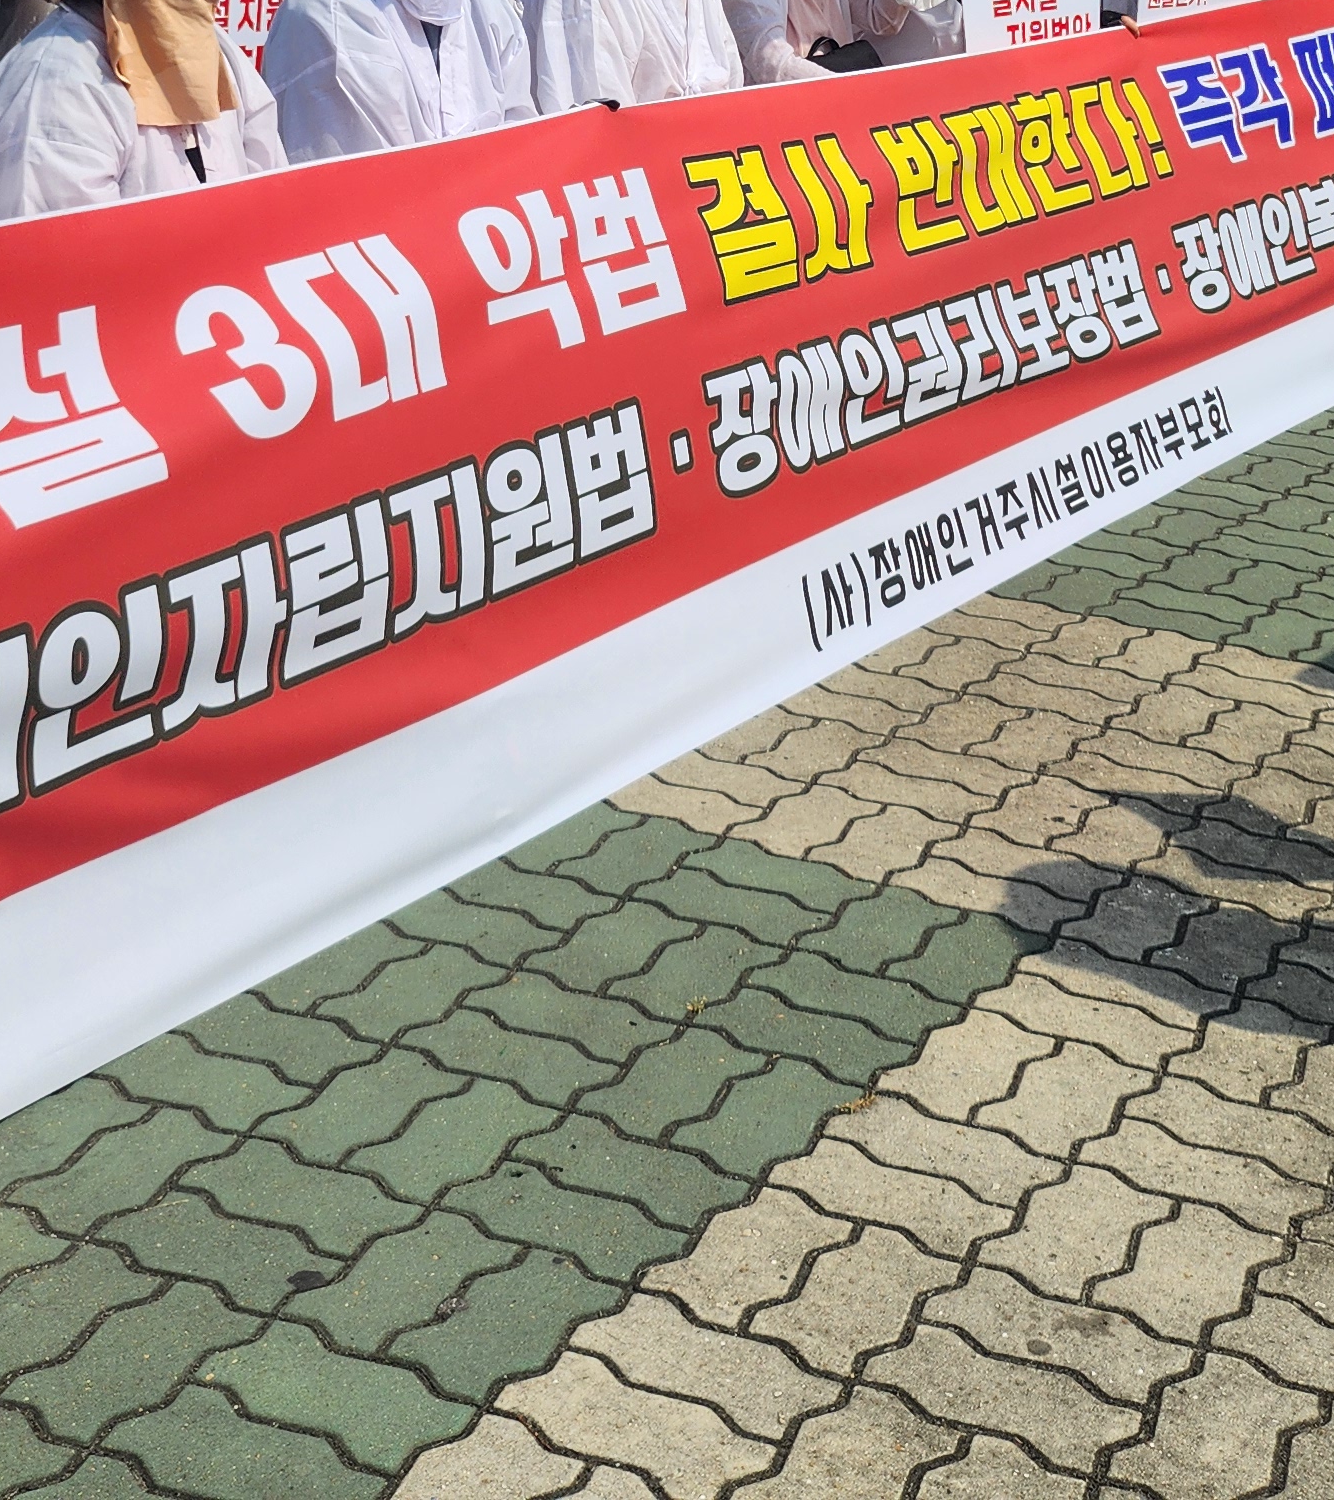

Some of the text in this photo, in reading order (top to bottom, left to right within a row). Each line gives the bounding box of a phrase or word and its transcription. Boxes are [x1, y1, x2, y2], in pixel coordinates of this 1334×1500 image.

[173, 233, 448, 442] 3대
[465, 167, 689, 349] 악법
[685, 134, 875, 305] 결사
[872, 75, 1175, 254] 반대한다!
[1158, 43, 1296, 164] 즉각
[702, 243, 1161, 498] 장애인권리보장법
[801, 385, 1234, 653] (사)장애인거주시설이용자부모회
